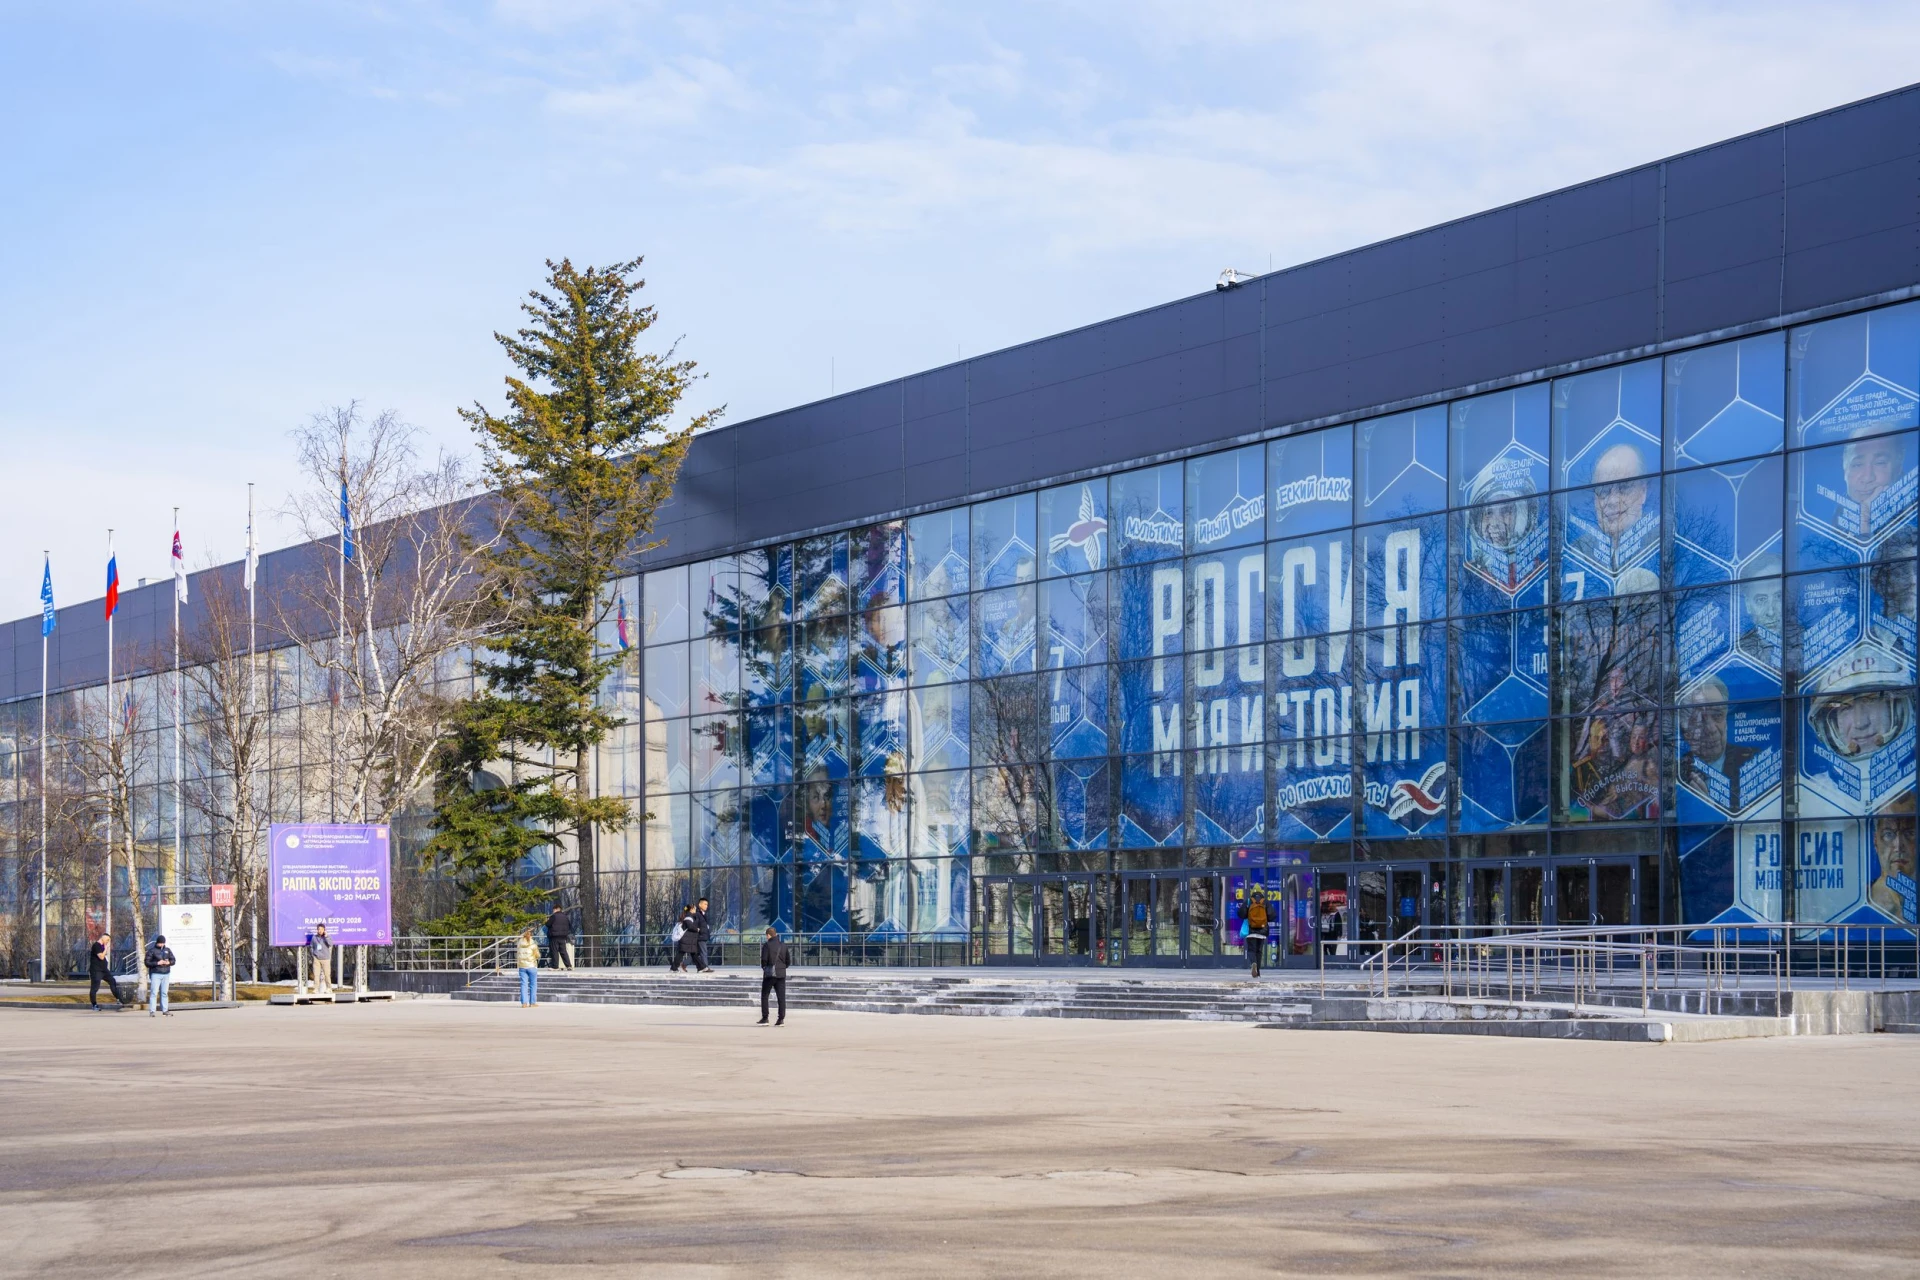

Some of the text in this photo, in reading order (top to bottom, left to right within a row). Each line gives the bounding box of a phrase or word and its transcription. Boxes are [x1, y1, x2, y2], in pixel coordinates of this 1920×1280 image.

[1317, 476, 1352, 501] ПАРК
[1153, 528, 1420, 691] РОССИЯ
[1577, 771, 1638, 807] Обновленная
[1616, 782, 1659, 796] выставка
[1256, 775, 1388, 833] ДРО ПОЖАЛОТЬ!
[1755, 831, 1844, 867] РОСИЯ
[282, 877, 380, 891] РАППА ЭКСПО 2026
[1755, 868, 1844, 890] МОЯ СТОРИЯ
[355, 893, 380, 901] МАРТА
